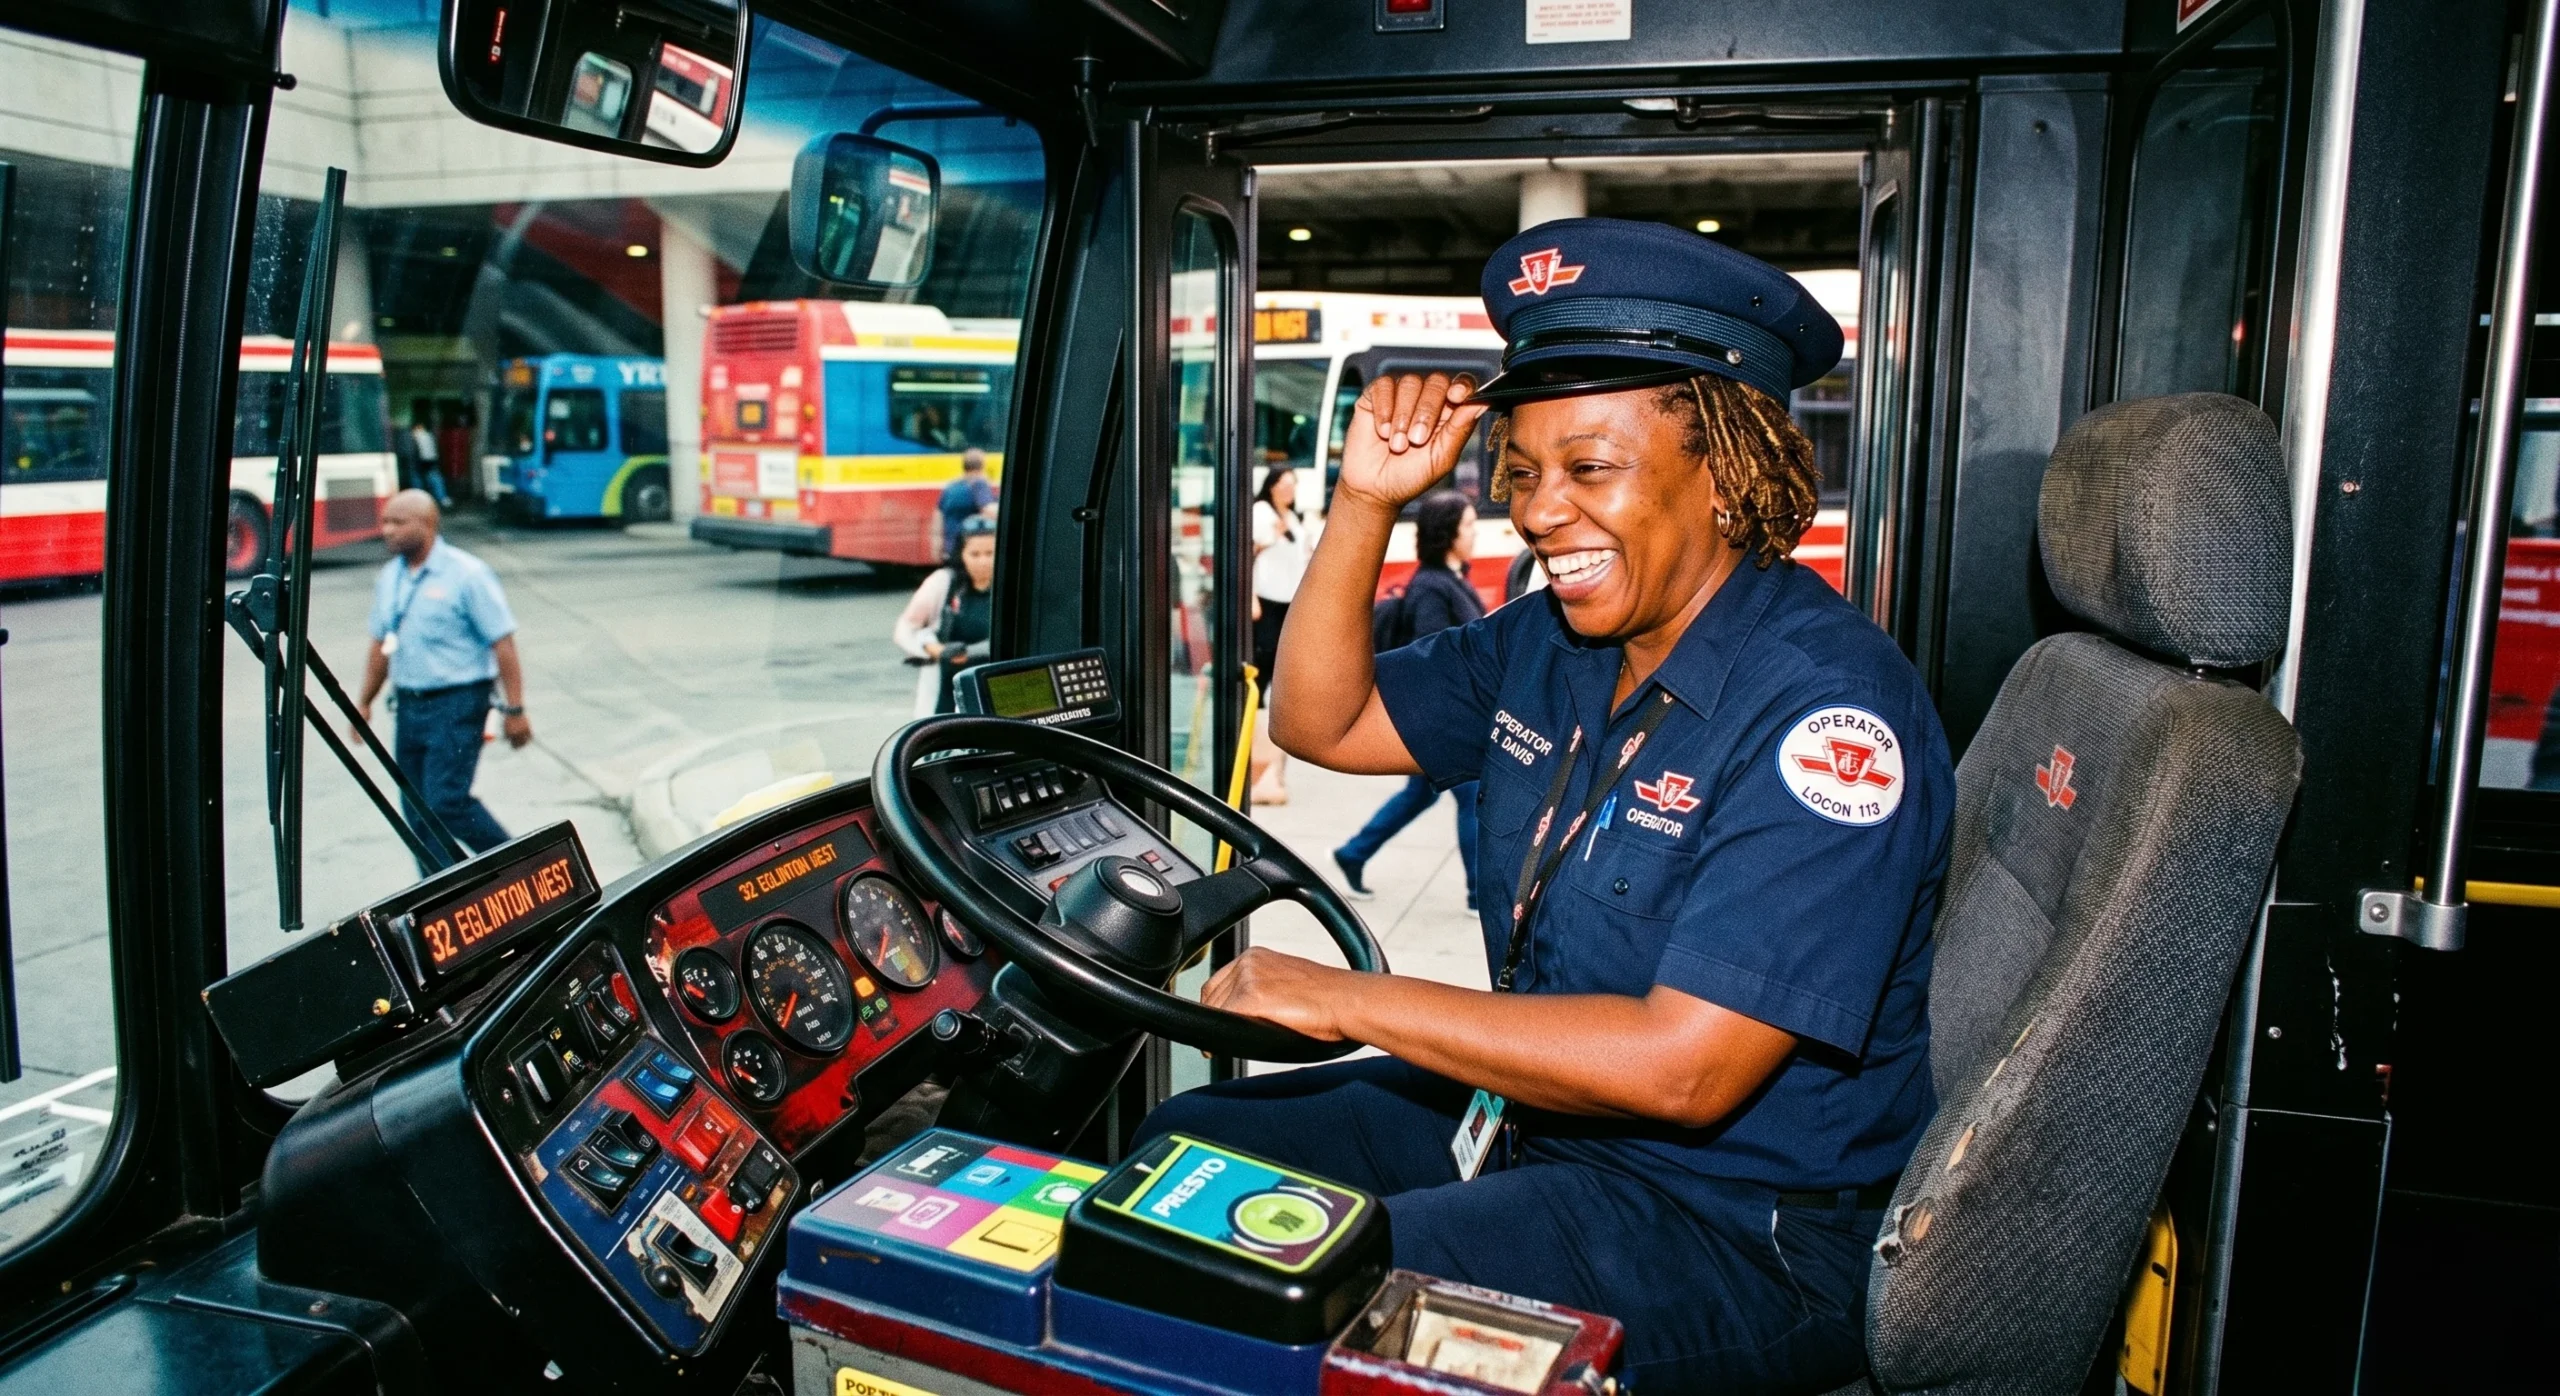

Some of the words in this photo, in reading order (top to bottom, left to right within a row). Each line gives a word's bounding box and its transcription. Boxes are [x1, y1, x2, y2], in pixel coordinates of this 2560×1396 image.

[1491, 727, 1499, 743] B.
[1501, 736, 1535, 765] DAVIS
[1495, 710, 1552, 756] OPERATOR
[1808, 715, 1893, 752] OPERATOR
[1802, 786, 1851, 816] LOCON
[1859, 803, 1880, 817] 113
[738, 882, 758, 902] 32
[756, 857, 811, 892] EGLINTON
[424, 919, 458, 963] 32
[455, 879, 535, 943] EGLINTON
[533, 858, 575, 903] WEST
[1151, 1158, 1227, 1218] PRESTO
